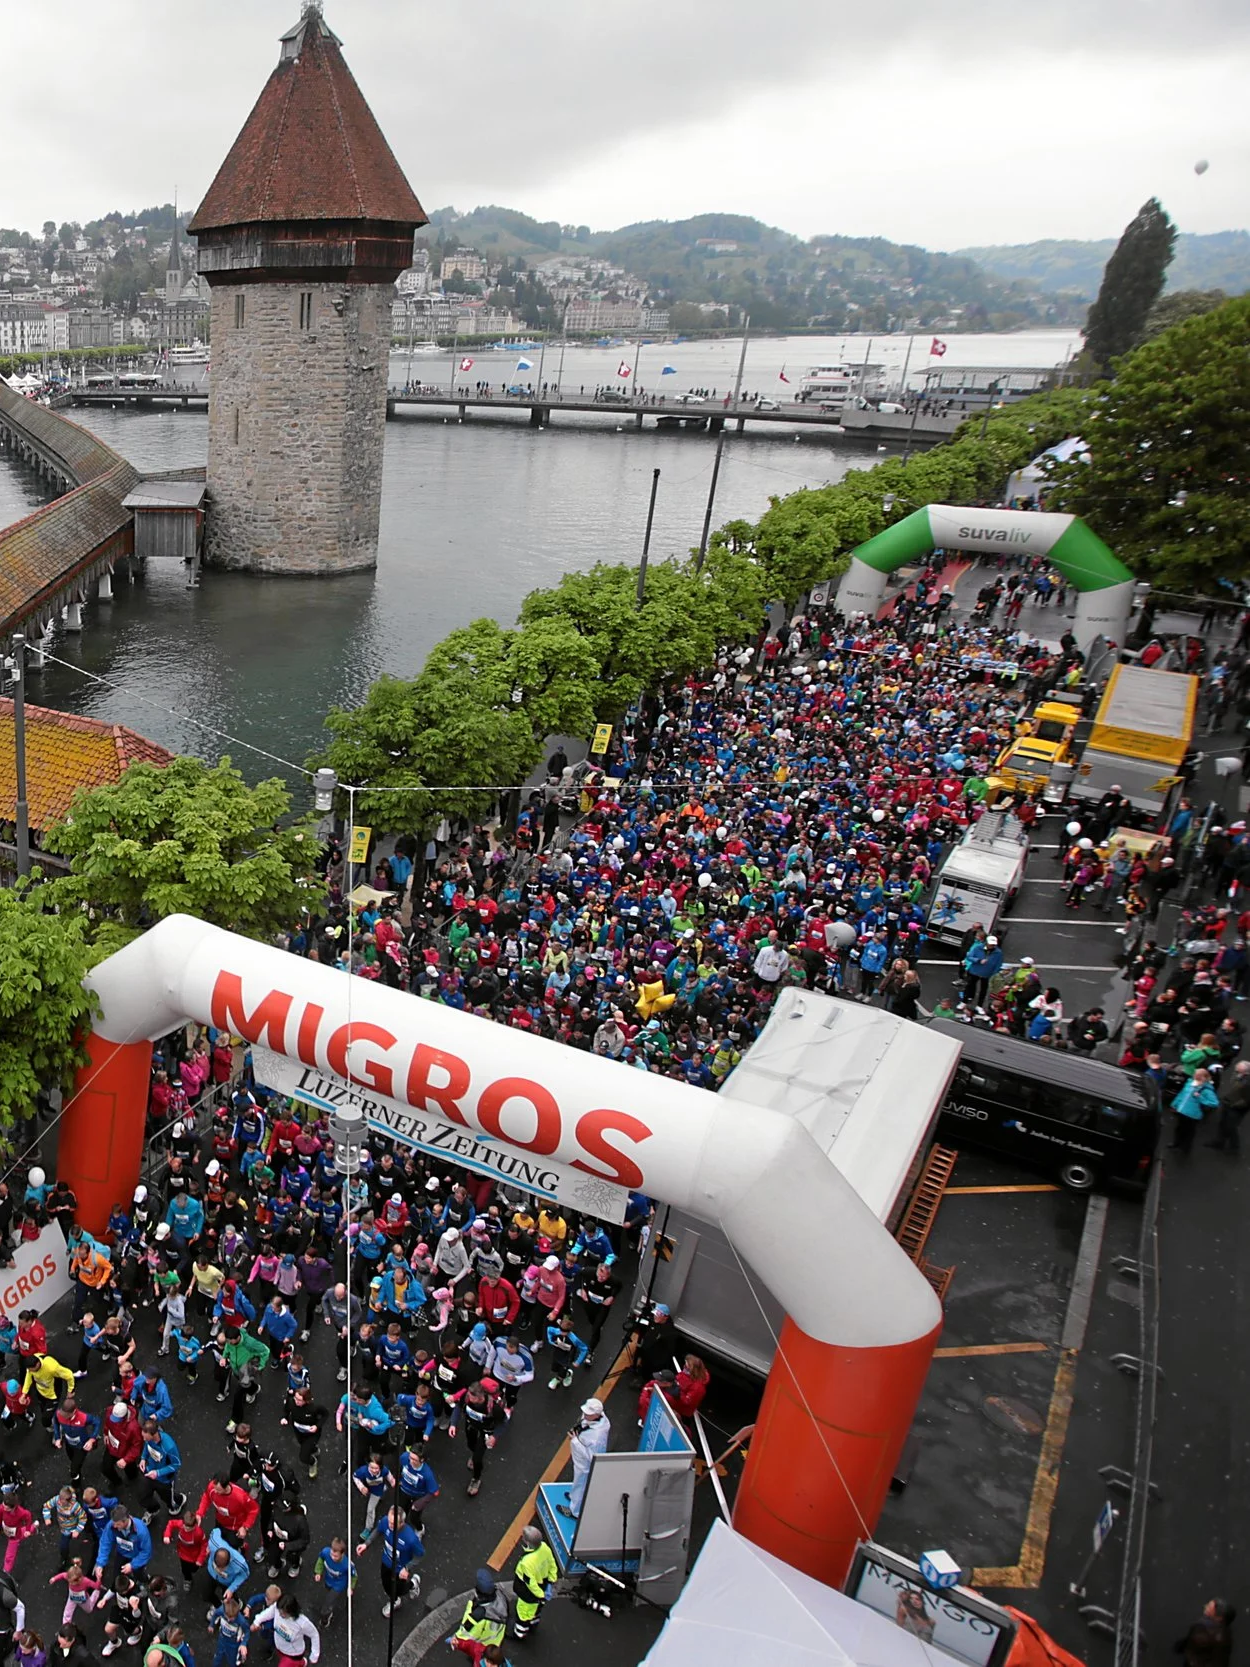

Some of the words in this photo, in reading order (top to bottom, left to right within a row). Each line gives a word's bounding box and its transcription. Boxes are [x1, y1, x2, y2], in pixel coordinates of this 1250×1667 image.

[958, 526, 1032, 543] suvaliv
[210, 970, 652, 1188] MIGROS
[296, 1068, 428, 1143] LUZERNER
[424, 1122, 560, 1193] ZEITUNG
